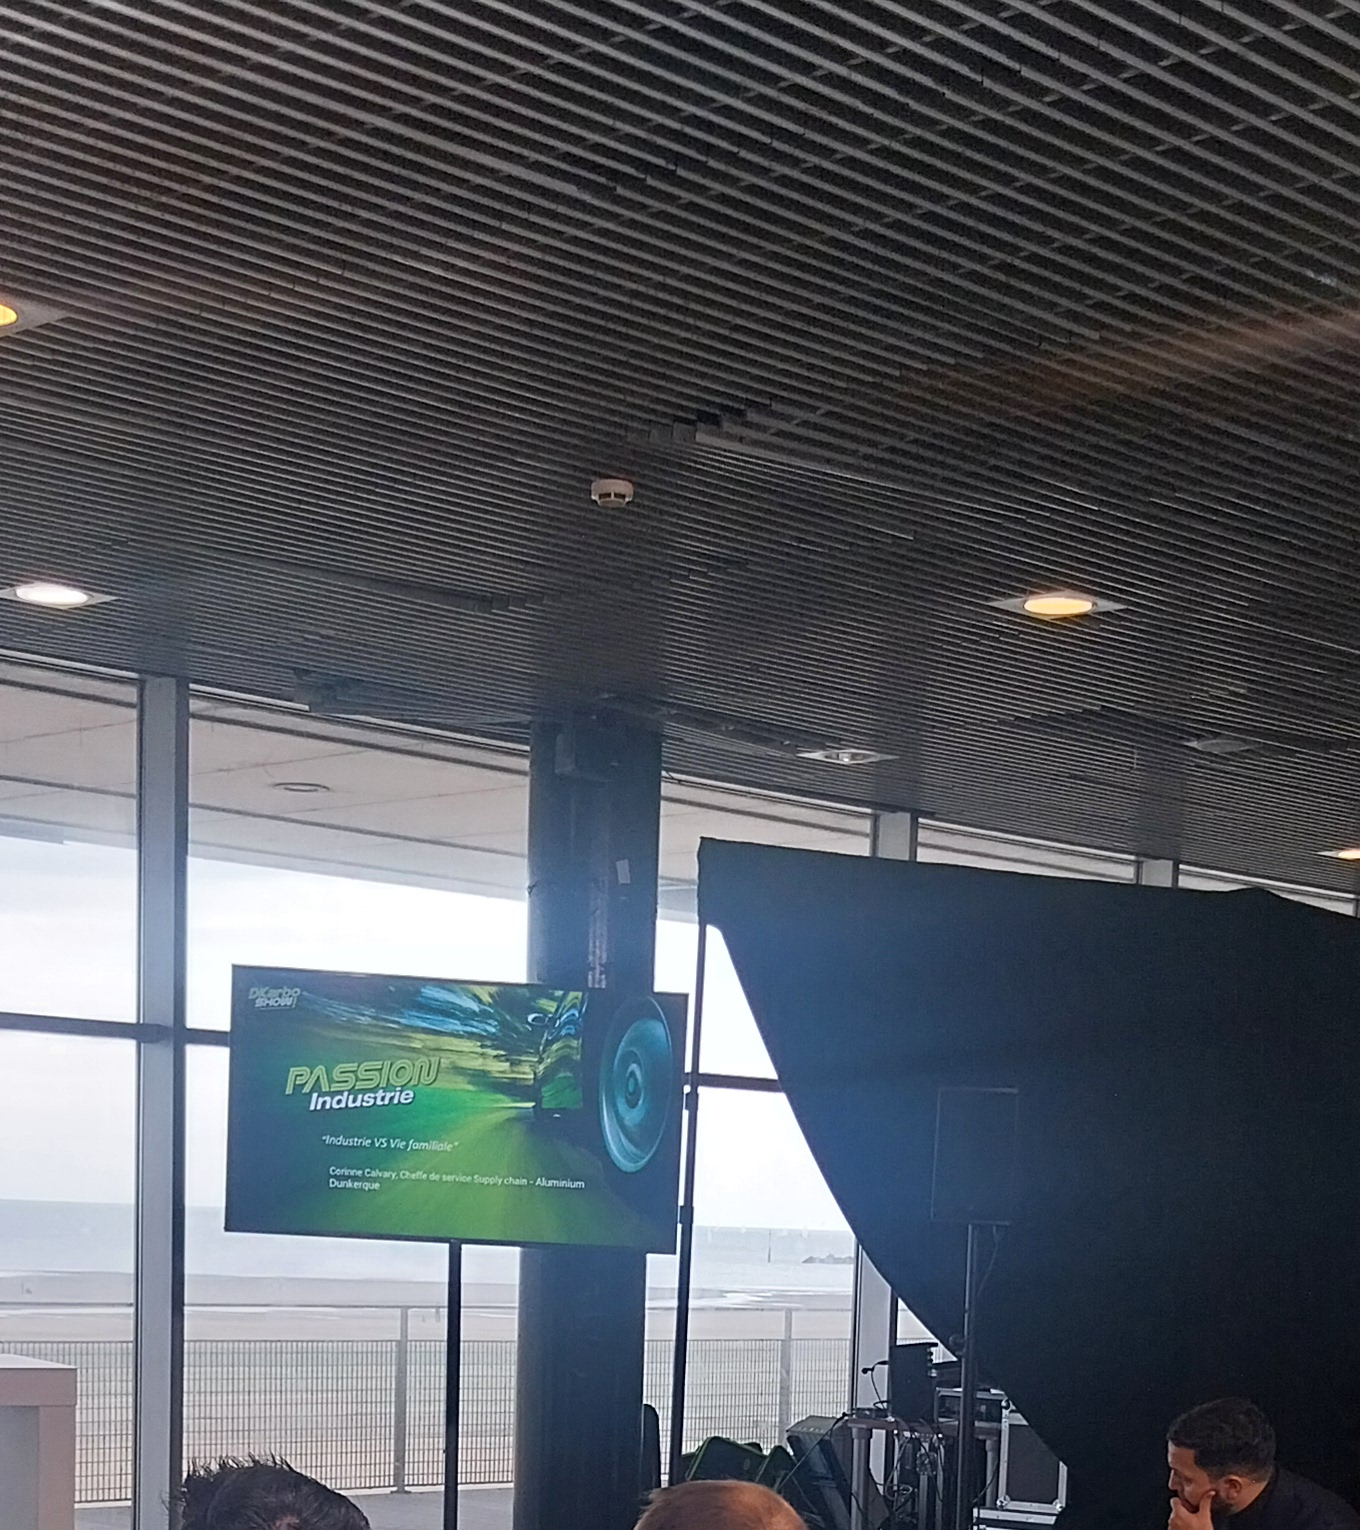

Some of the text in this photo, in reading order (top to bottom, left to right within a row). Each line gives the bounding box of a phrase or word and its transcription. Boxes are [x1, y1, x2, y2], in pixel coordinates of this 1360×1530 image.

[285, 1057, 440, 1095] PASSION
[309, 1087, 414, 1111] Industrie
[374, 1138, 388, 1148] VS
[390, 1139, 406, 1149] Vie
[329, 1166, 363, 1177] Corinne
[400, 1170, 428, 1180] Cheffe
[429, 1172, 440, 1181] de
[441, 1174, 472, 1183] service
[473, 1175, 503, 1186] Supply
[504, 1176, 528, 1186] chain
[535, 1177, 585, 1189] Aluminium
[329, 1178, 380, 1191] Dunkerque
